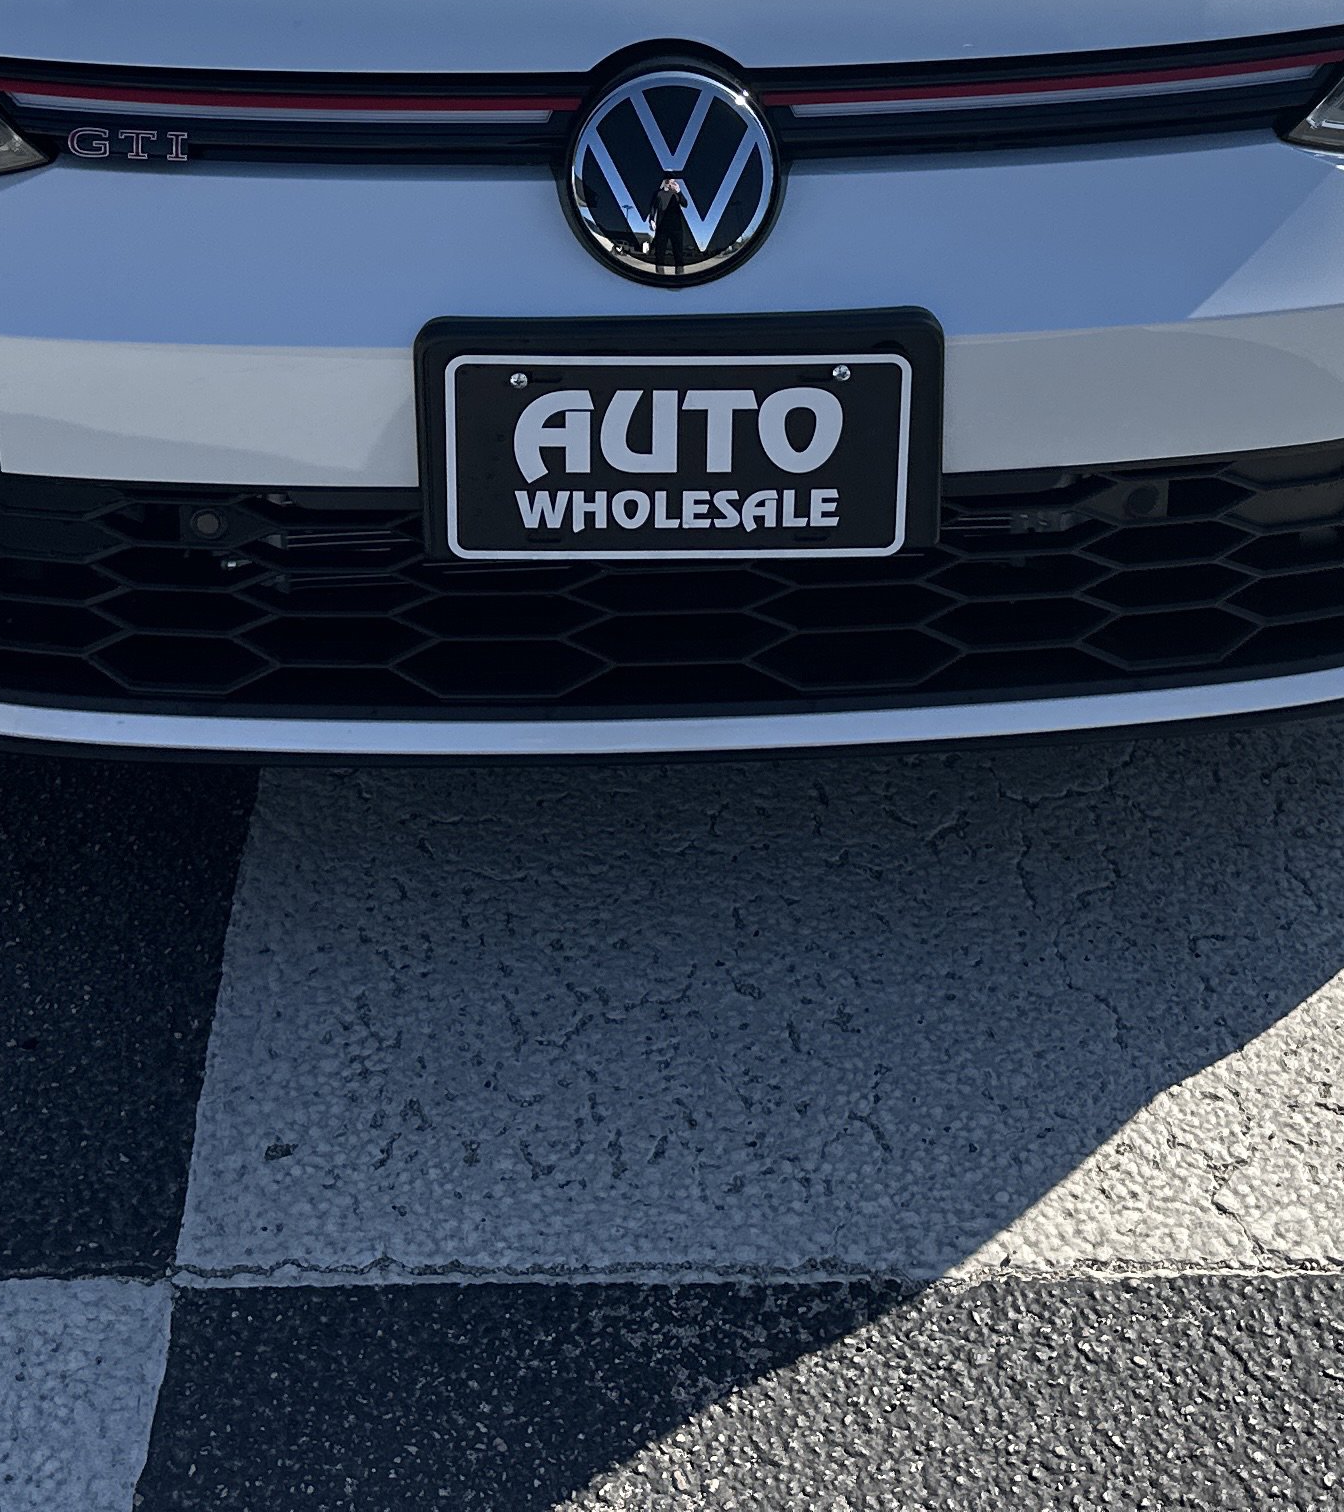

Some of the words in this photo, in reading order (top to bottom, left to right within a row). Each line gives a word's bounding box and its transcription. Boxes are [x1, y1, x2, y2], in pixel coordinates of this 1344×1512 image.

[68, 127, 188, 161] GTI
[513, 387, 843, 484] AUTO
[514, 488, 840, 533] WHOLESALE
